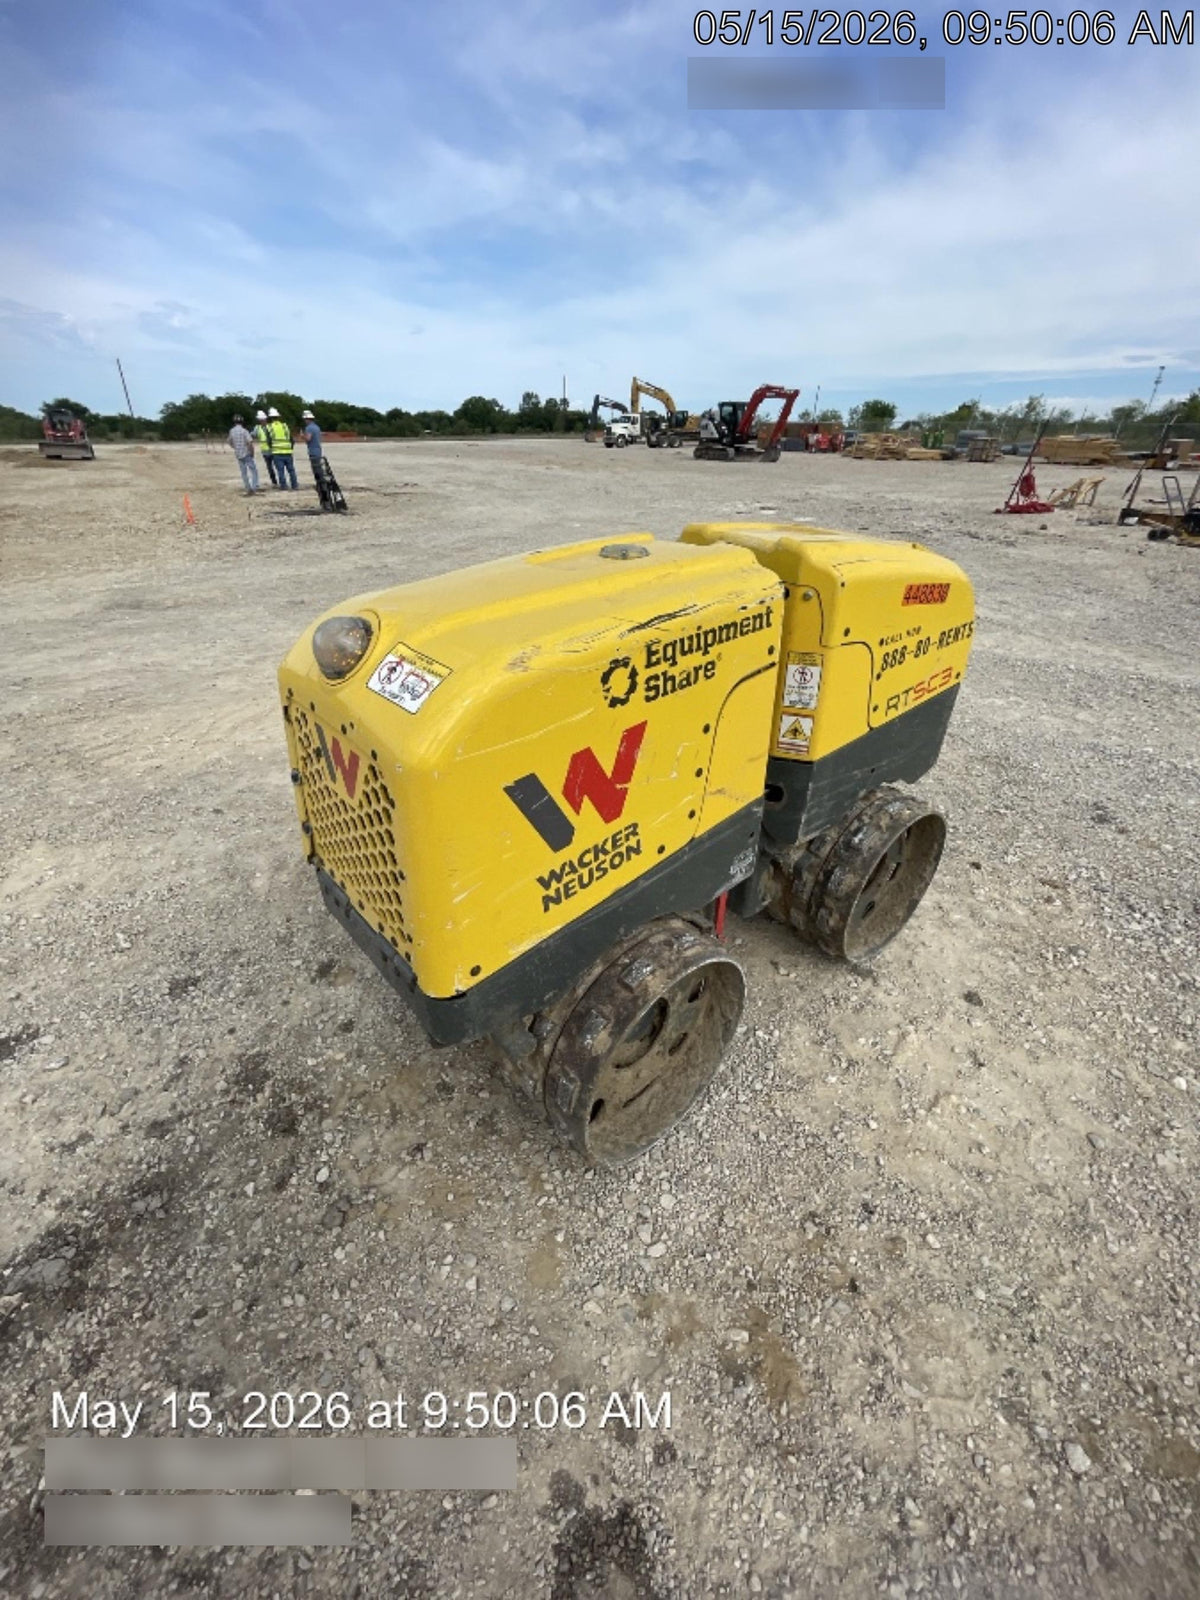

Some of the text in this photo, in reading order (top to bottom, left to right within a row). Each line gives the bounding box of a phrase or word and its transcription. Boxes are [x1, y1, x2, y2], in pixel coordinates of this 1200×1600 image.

[644, 606, 773, 668] Equipment
[881, 621, 974, 672] 888-80-RENTS
[644, 659, 716, 703] Share
[536, 822, 640, 891] WACKER
[541, 839, 643, 914] NEUSON
